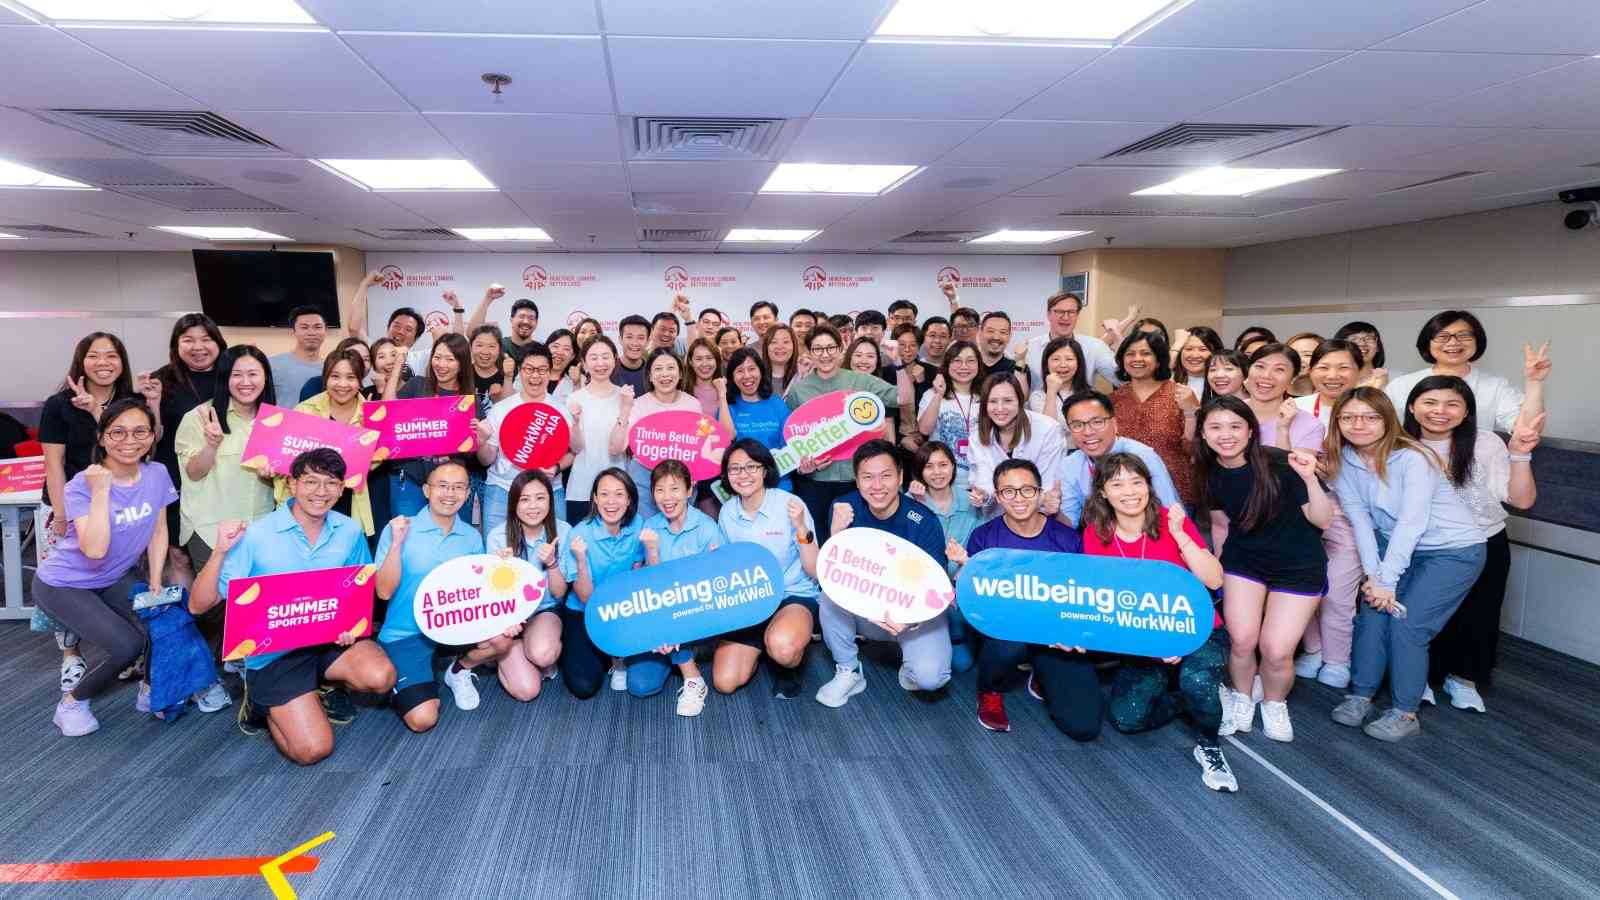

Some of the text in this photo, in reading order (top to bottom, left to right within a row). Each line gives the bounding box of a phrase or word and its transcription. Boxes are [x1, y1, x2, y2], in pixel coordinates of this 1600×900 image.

[394, 419, 448, 433] SUMMER
[396, 430, 448, 441] SPORTS FEST
[514, 410, 549, 464] WorkWell
[545, 415, 561, 436] AIA
[636, 426, 700, 446] Thrive Better
[635, 440, 699, 462] Together
[776, 419, 848, 470] in Better
[115, 502, 152, 525] FILA
[828, 544, 887, 576] A Better
[597, 565, 770, 622] wellbeing@AIA
[715, 582, 774, 609] WorkWell
[824, 560, 916, 608] Tomorrow
[972, 574, 1194, 616] wellbeing@AIA
[267, 598, 339, 619] SUMMER
[423, 587, 482, 609] A Better
[267, 611, 337, 630] SPORTS FEST
[422, 598, 516, 630] Tomorrow
[1060, 610, 1197, 634] powered by WorkWell
